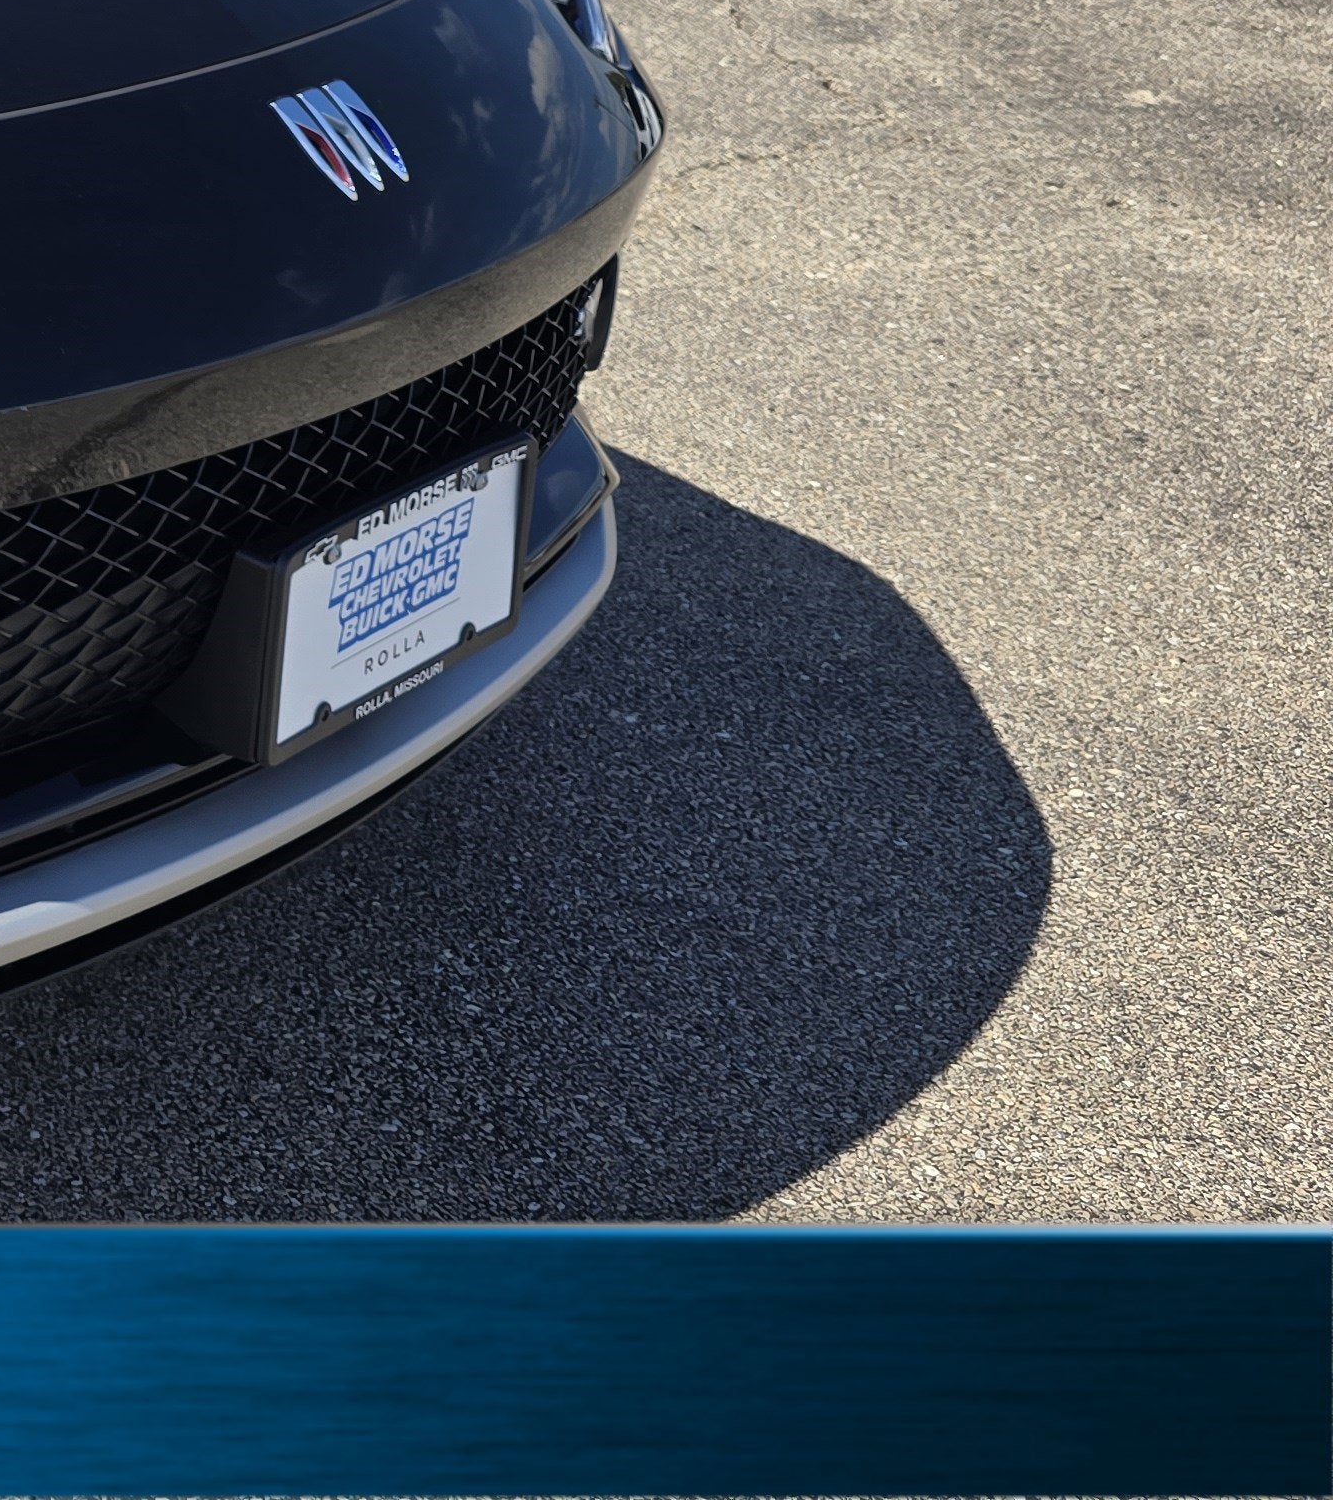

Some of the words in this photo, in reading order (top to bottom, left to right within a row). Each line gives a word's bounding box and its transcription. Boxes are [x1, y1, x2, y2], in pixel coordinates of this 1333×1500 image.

[358, 509, 384, 538] ED
[388, 473, 458, 526] MORSE
[491, 445, 528, 470] GMC
[331, 553, 371, 602] ED
[373, 500, 474, 576] MORSE
[340, 539, 461, 620] CHEVROLET
[363, 630, 426, 676] ROLLA
[393, 660, 445, 699] MISSOURI
